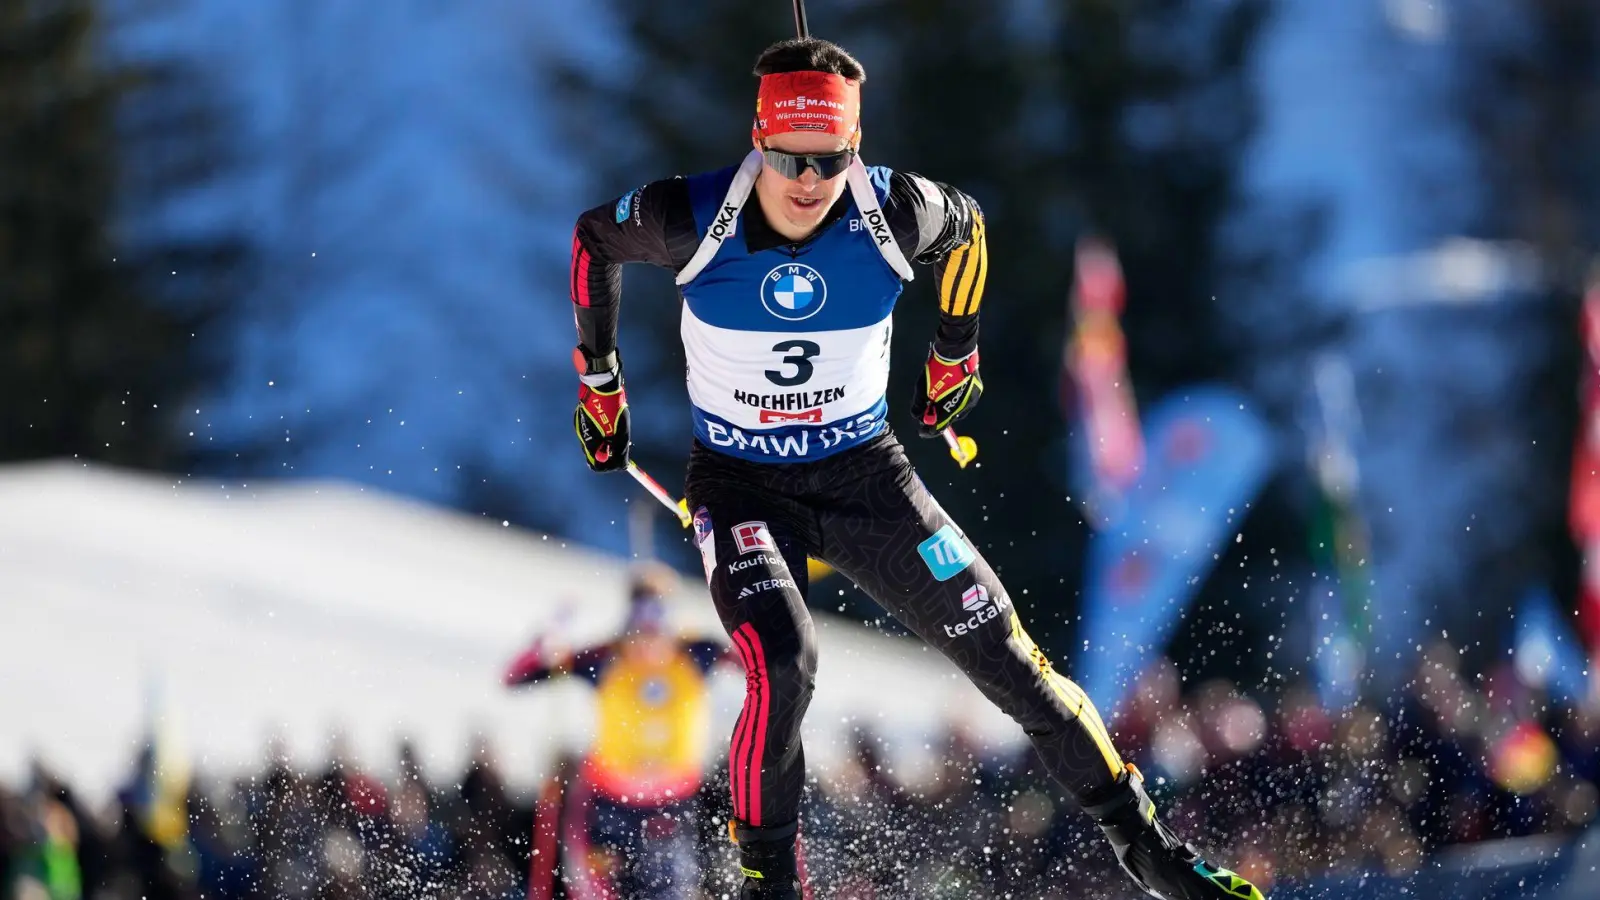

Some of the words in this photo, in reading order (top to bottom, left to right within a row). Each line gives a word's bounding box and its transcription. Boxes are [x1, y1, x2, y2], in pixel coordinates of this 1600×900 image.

[774, 95, 845, 110] VIESSMANN
[776, 112, 843, 122] Wärmepumpen
[849, 219, 868, 232] BM
[771, 266, 818, 282] BMW
[764, 339, 821, 387] 3
[734, 385, 846, 411] HOCHFILZEN
[592, 398, 613, 434] LEKI
[703, 418, 809, 458] BMW
[728, 554, 786, 575] Kauflan
[752, 579, 797, 593] TERRE
